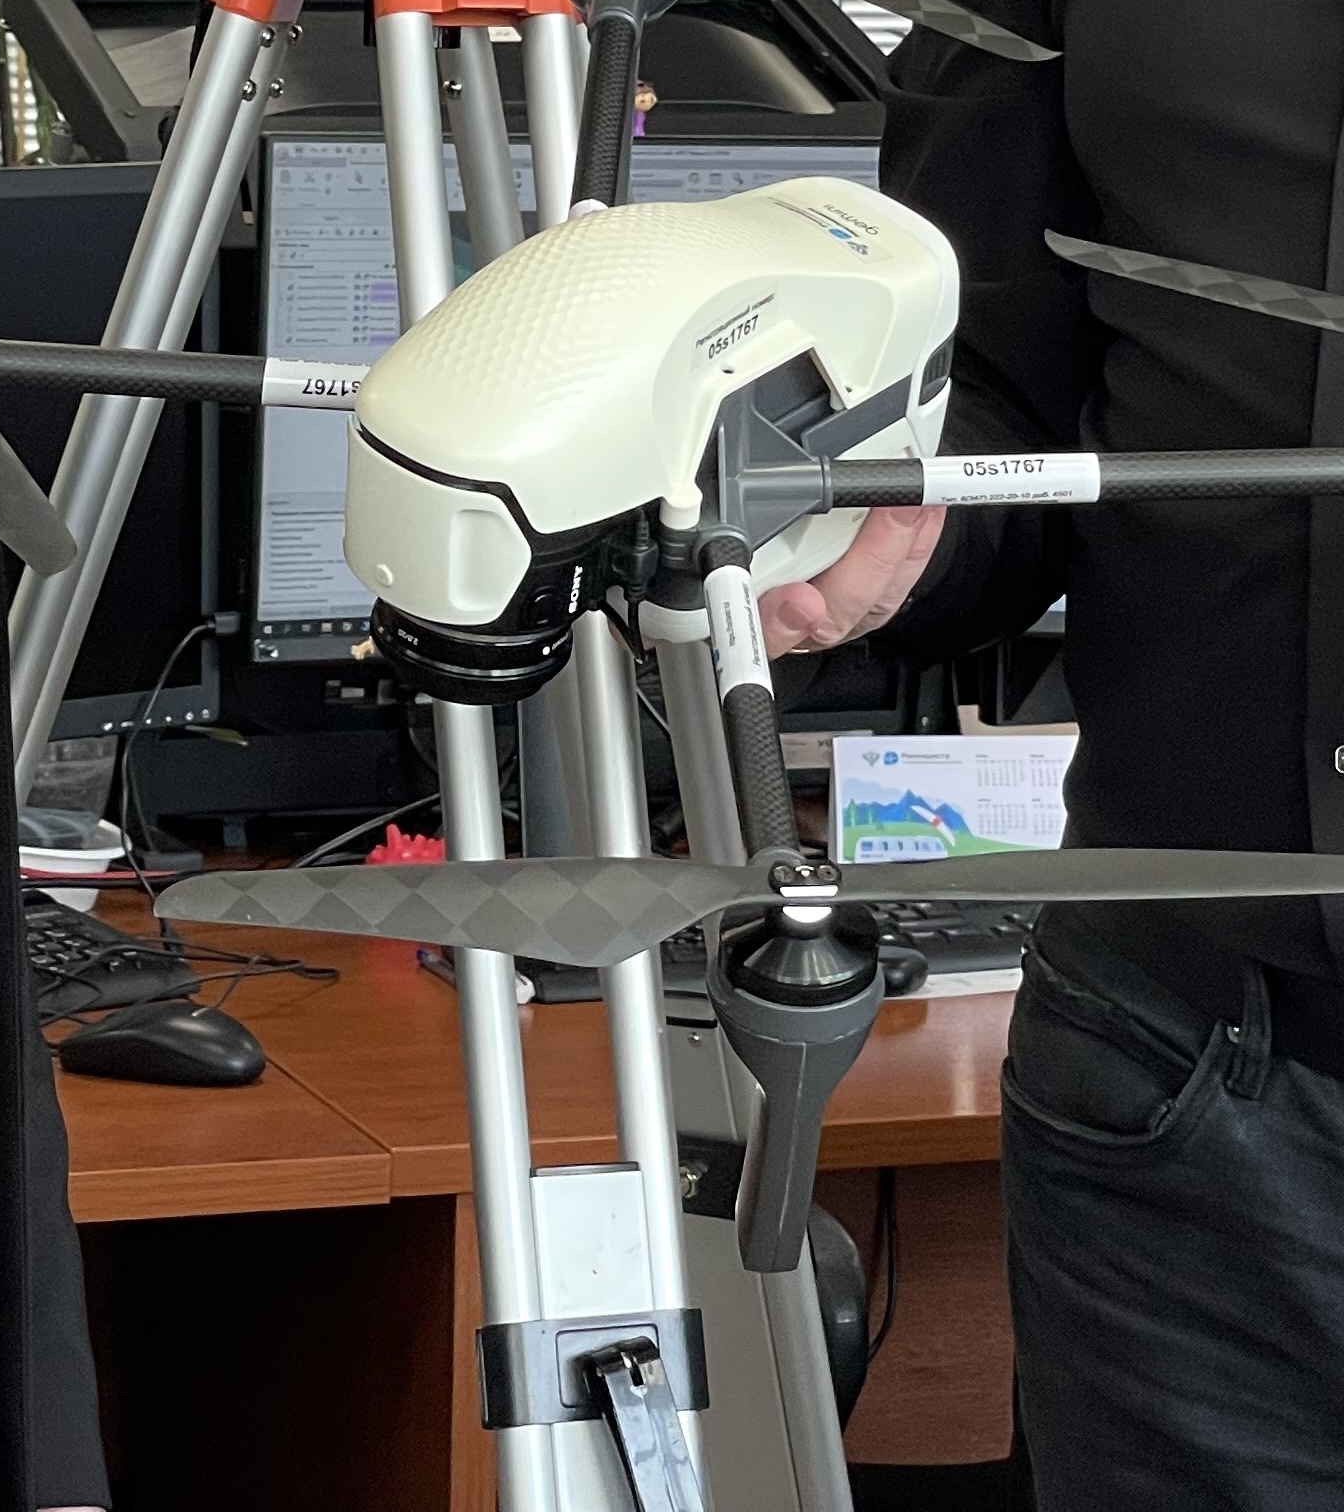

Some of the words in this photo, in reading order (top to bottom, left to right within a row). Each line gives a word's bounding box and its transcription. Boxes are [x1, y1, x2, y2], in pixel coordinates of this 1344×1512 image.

[708, 314, 759, 359] 05s1767
[963, 459, 1045, 477] 05s1767
[568, 565, 583, 614] SONY
